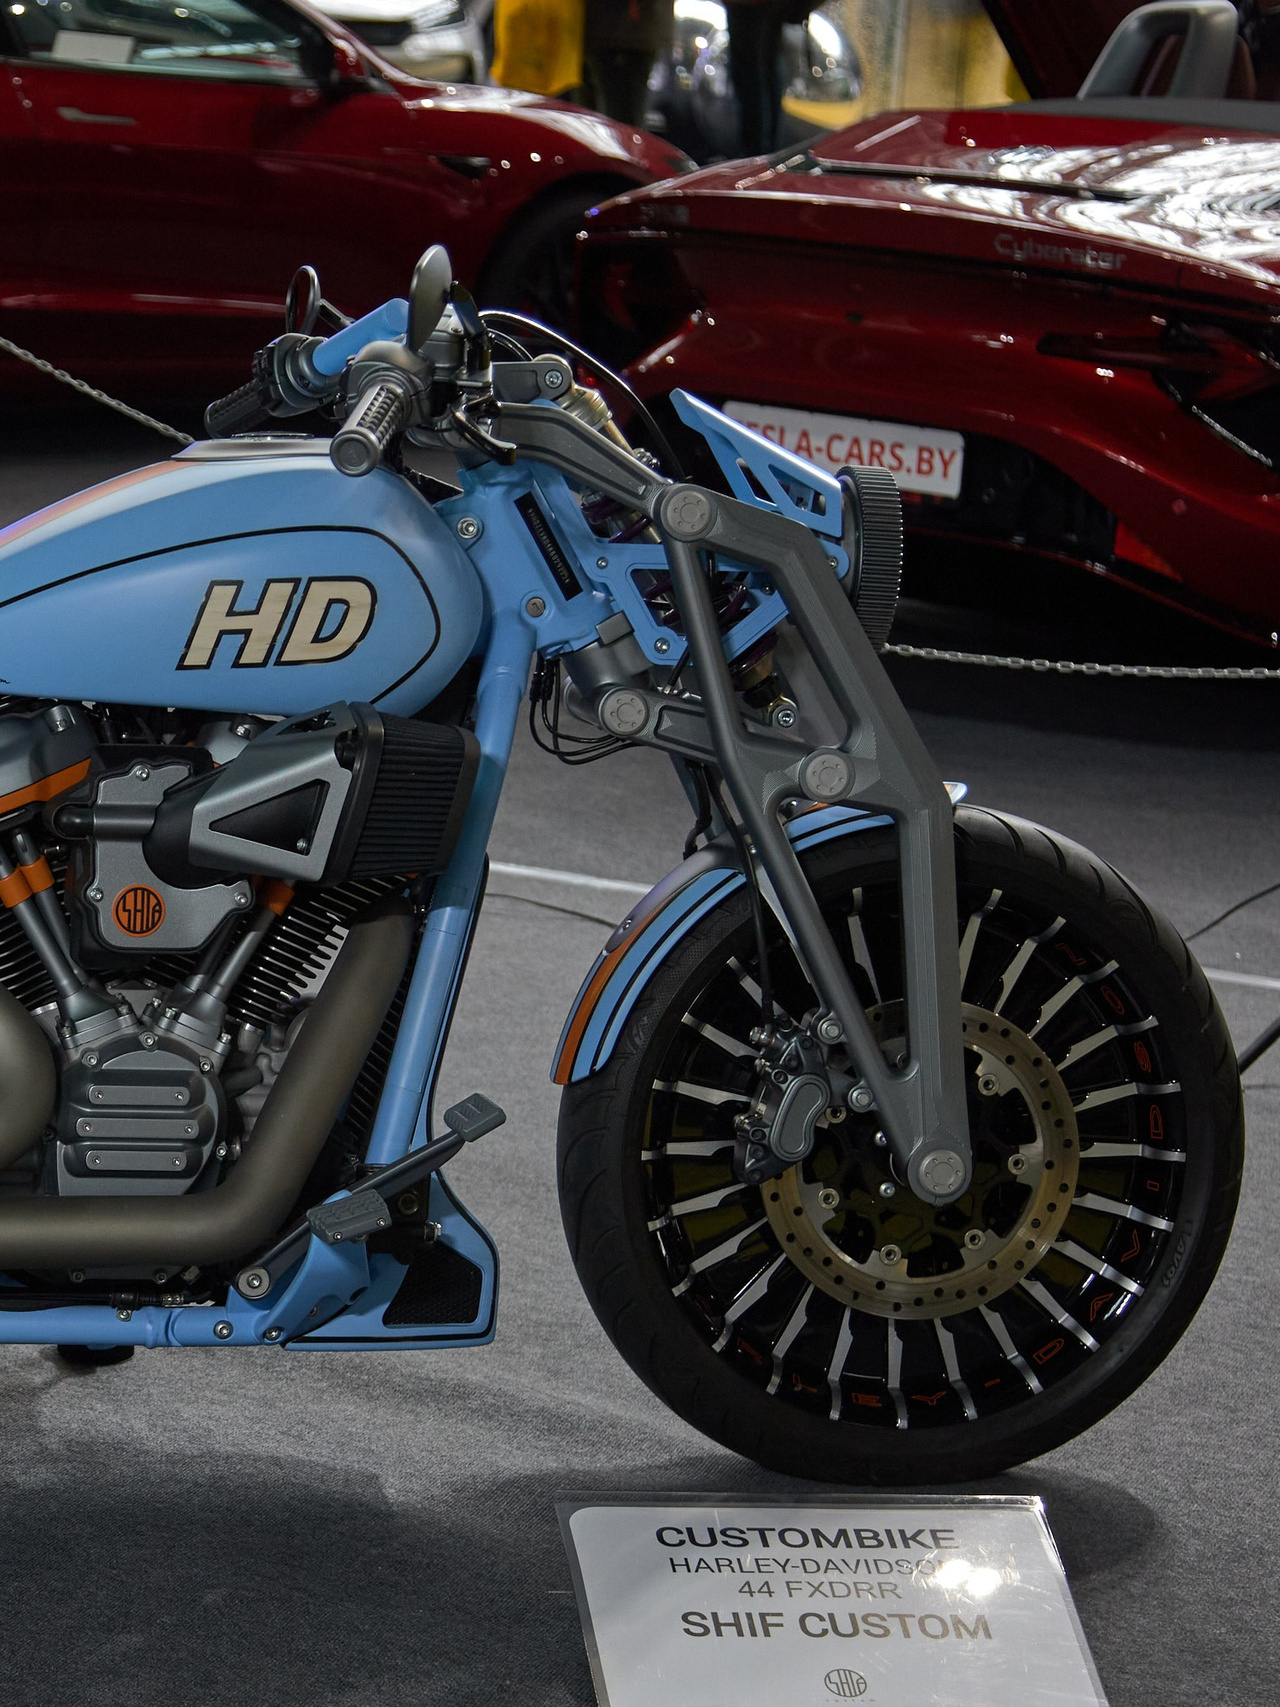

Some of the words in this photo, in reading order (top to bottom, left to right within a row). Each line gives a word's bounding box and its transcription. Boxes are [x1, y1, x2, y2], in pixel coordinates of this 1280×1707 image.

[175, 575, 378, 671] HD
[656, 1526, 960, 1549] CUSTOMBIKE
[670, 1557, 946, 1576] HARLEY-DAVIDSO
[738, 1580, 775, 1598] 44
[786, 1580, 903, 1599] FXDRR
[681, 1611, 784, 1638] SHIF
[798, 1612, 993, 1640] CUSTOM
